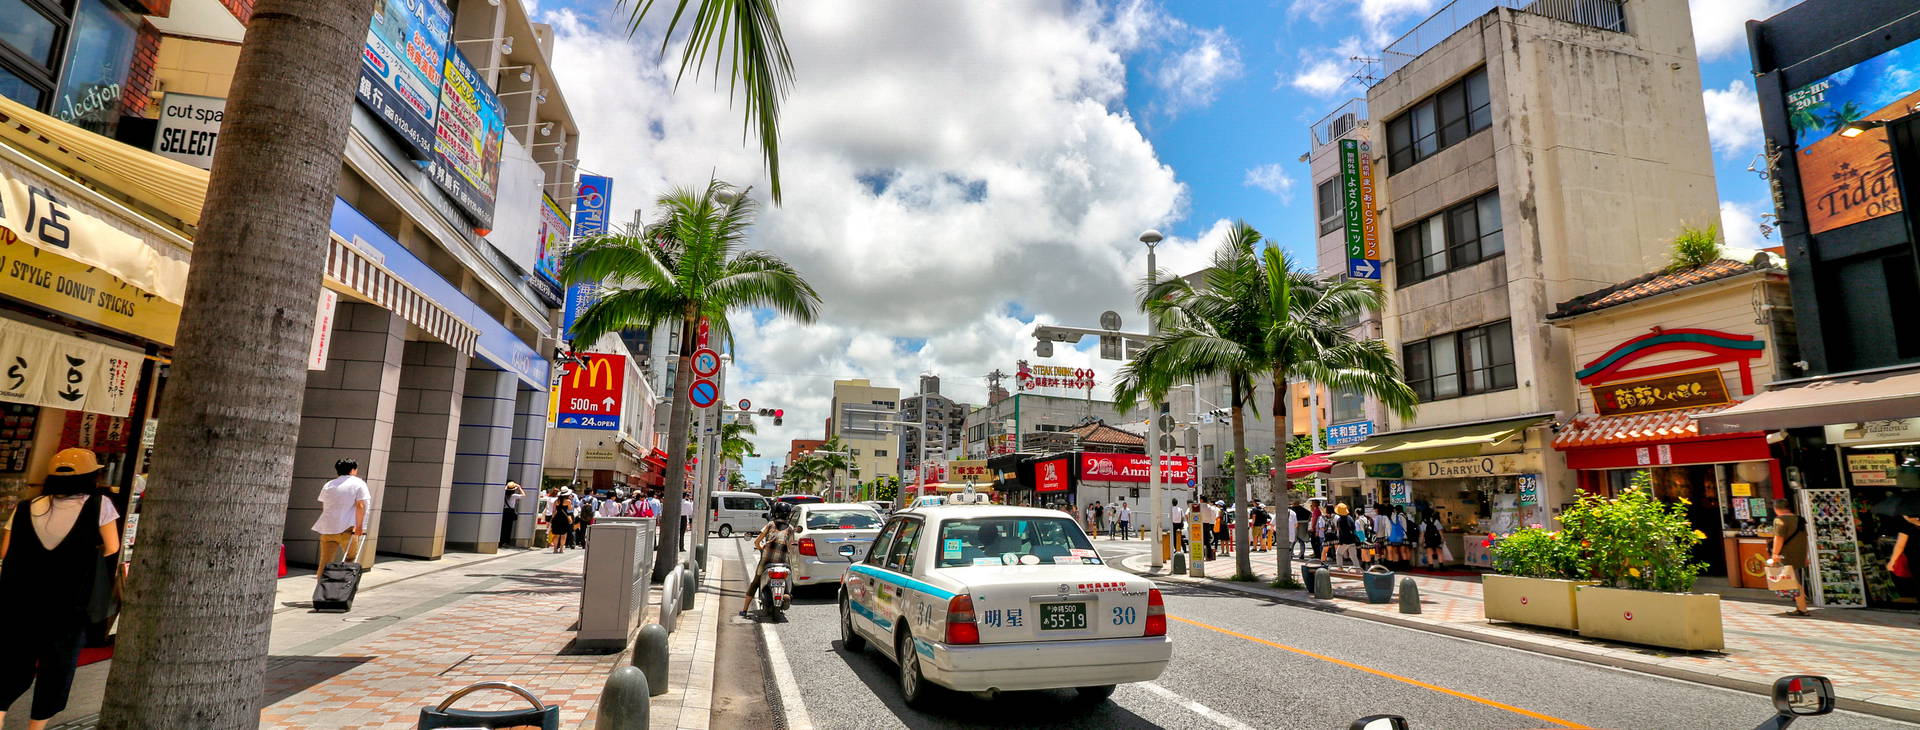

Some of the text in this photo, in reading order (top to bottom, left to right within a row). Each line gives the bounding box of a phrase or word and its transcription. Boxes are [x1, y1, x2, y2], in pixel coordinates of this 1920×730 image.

[1788, 80, 1830, 104] K2-HN
[1795, 93, 1825, 111] 2011
[167, 104, 224, 125] cut spa
[161, 127, 216, 157] SELECT
[10, 260, 135, 318] STYLE DONUT STICKS
[1033, 365, 1075, 377] STEAK DINING
[1330, 423, 1368, 438] 共和宝石
[984, 608, 1023, 628] 明星
[1050, 613, 1085, 629] 55-19
[1112, 606, 1136, 626] 30
